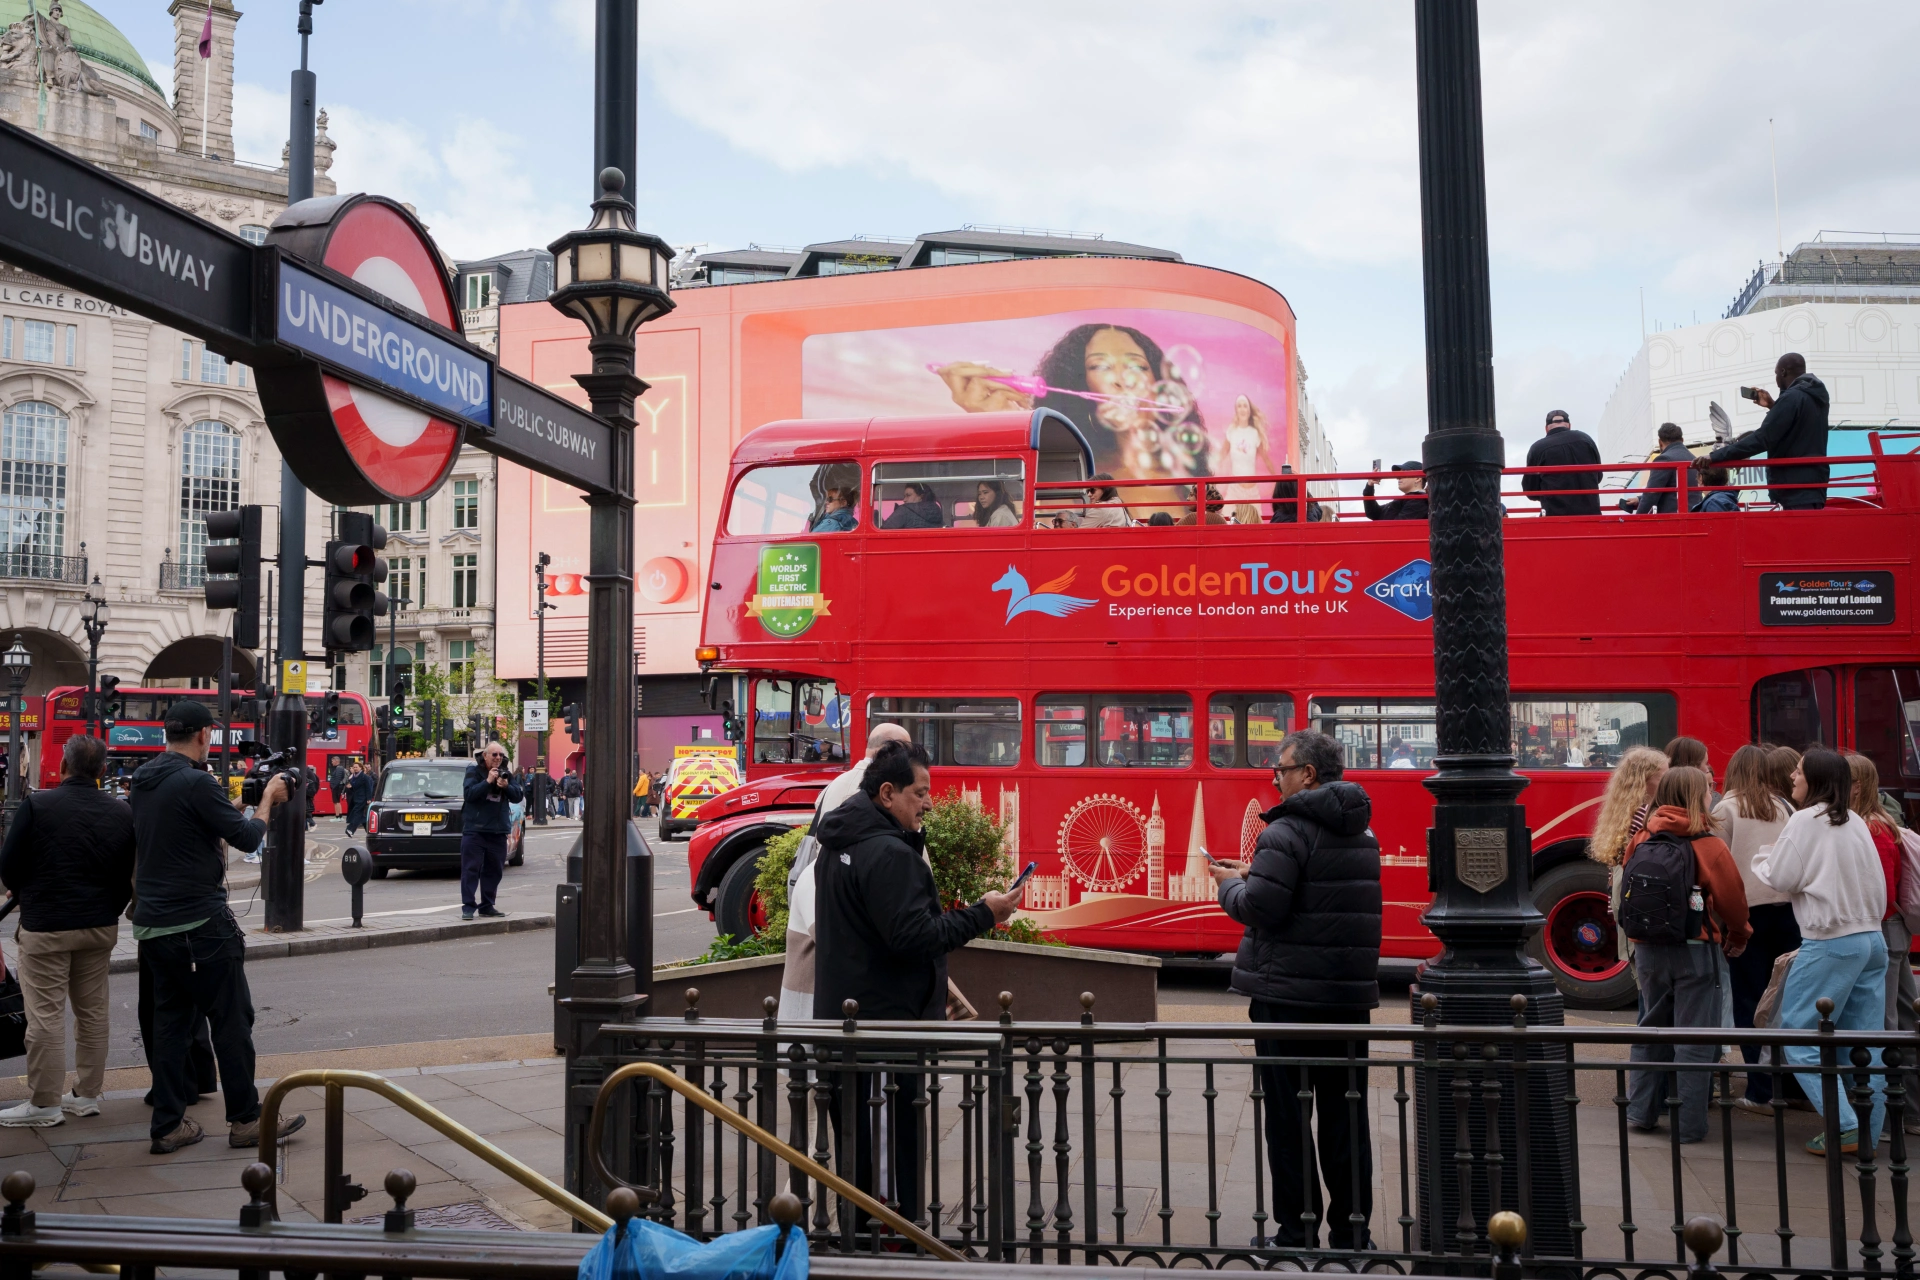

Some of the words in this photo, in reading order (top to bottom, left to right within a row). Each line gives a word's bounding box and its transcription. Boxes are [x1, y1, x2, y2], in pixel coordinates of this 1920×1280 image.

[20, 290, 64, 308] CAFÉ
[285, 282, 485, 406] UNDERGROUND
[500, 398, 544, 438] PUBLIC
[546, 420, 597, 461] SUBWAY
[769, 564, 808, 573] WORLD'S
[777, 574, 800, 582] FIRST
[1101, 559, 1353, 597] GoldenTours
[769, 583, 807, 592] ELECTRIC
[1799, 580, 1853, 588] GoldenTours
[1375, 581, 1426, 600] Gray
[762, 595, 814, 607] ROUTEMASTER
[1770, 596, 1817, 605] Panoramic
[1818, 596, 1839, 604] Tour
[1840, 595, 1849, 604] of
[1850, 595, 1882, 604] London
[1109, 603, 1193, 620] Experience
[1198, 603, 1255, 616] London
[1260, 602, 1289, 615] and
[1294, 601, 1320, 615] the
[1326, 600, 1349, 614] UK
[1780, 608, 1874, 617] www.goldentours.com
[19, 714, 39, 723] ERE
